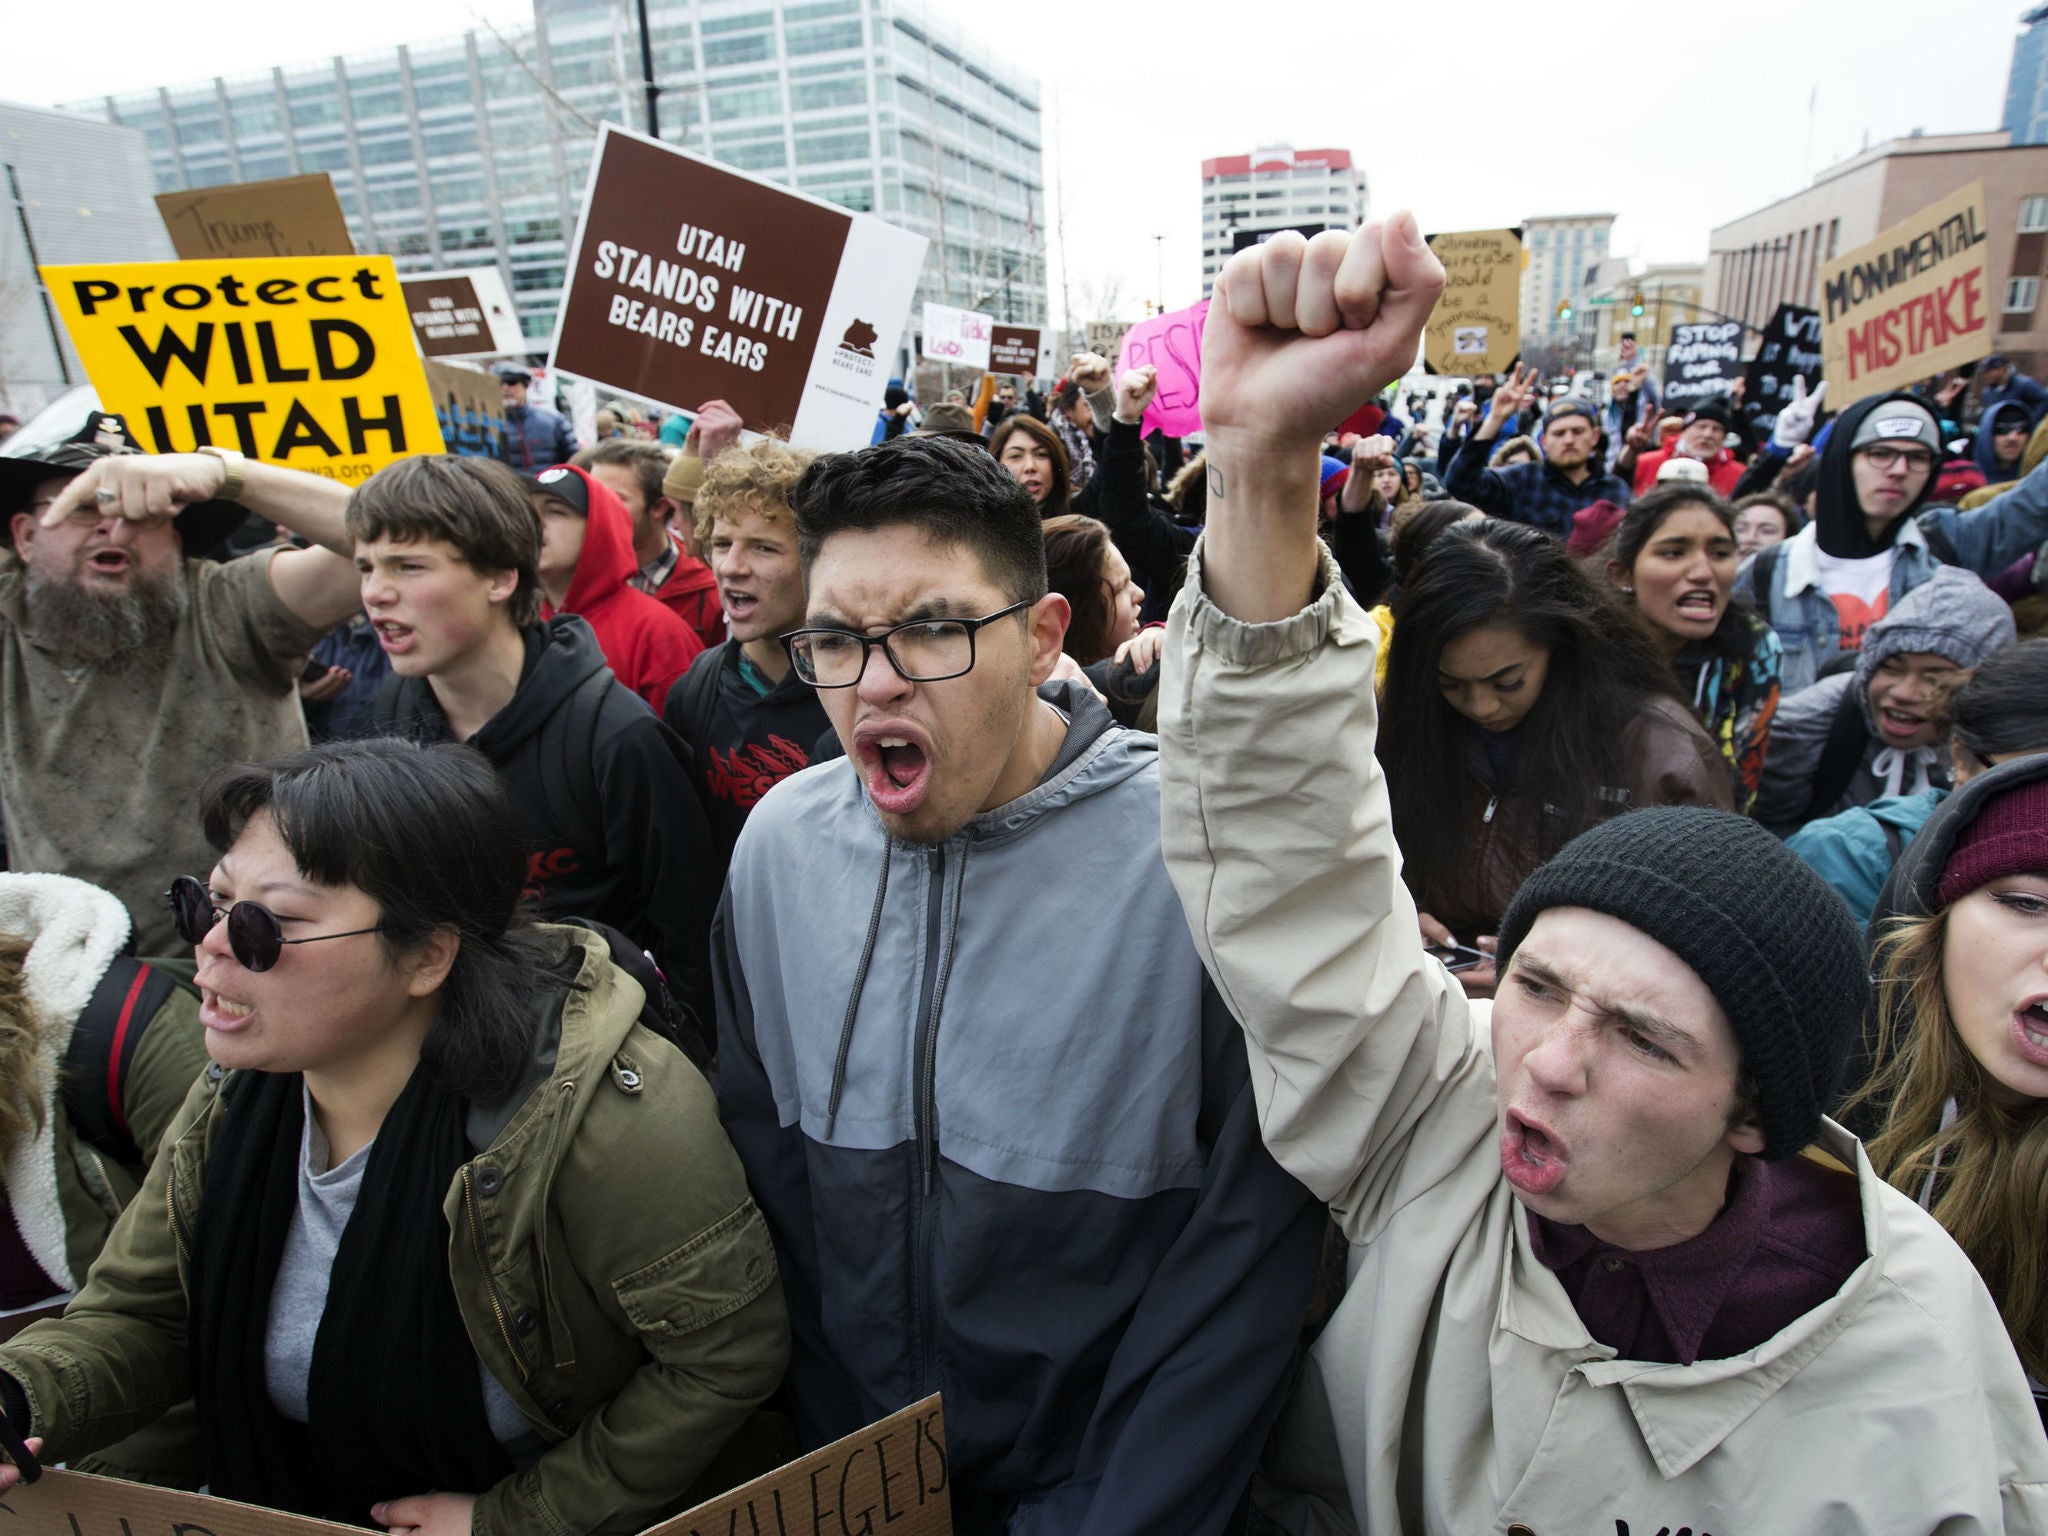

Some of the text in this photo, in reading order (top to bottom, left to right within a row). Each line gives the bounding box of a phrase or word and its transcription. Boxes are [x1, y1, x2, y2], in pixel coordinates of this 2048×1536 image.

[677, 222, 746, 273] UTAH
[1825, 206, 1987, 325] MONUMENTAL
[72, 268, 384, 316] Protect
[594, 240, 803, 342] STANDS WITH
[1848, 266, 1986, 381] MISTAKE
[117, 318, 376, 390] WILD
[608, 294, 768, 372] BEARS EARS
[1675, 322, 1741, 345] STOP
[146, 395, 407, 461] UTAH
